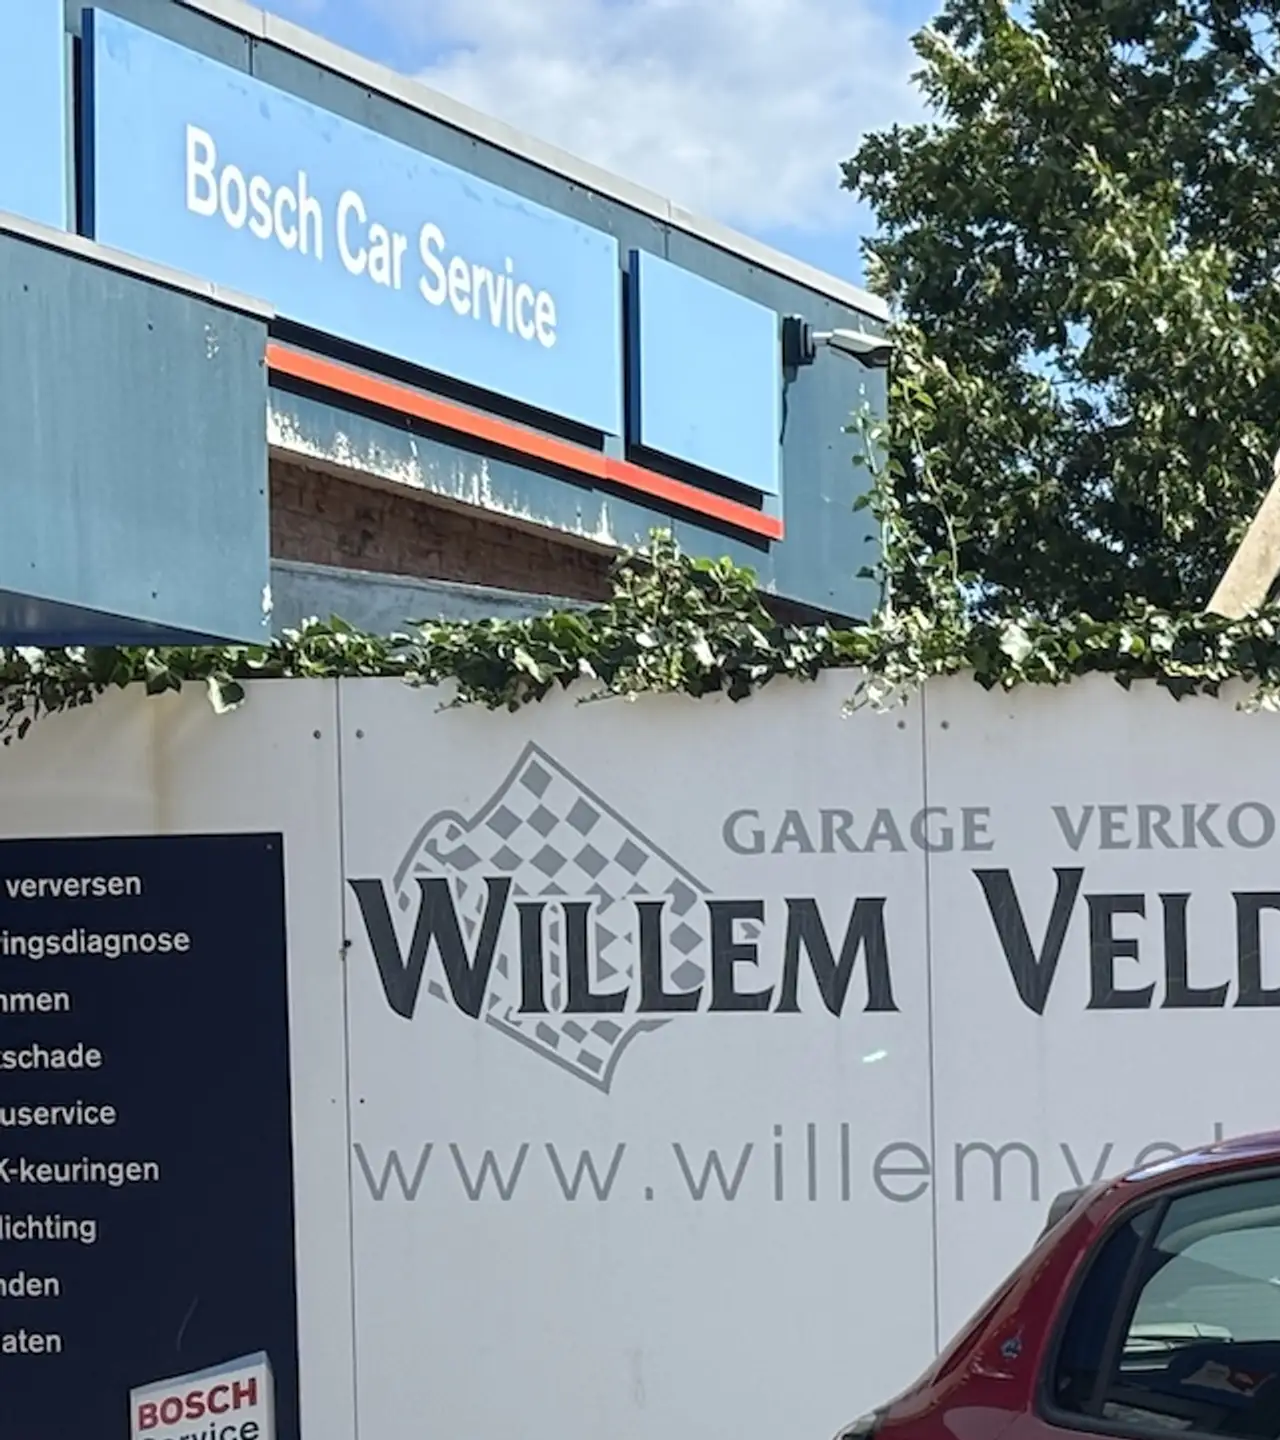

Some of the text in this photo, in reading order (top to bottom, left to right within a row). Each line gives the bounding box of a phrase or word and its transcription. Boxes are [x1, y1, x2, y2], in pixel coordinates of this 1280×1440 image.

[185, 124, 557, 348] Bosch Car Service
[722, 807, 994, 855] GARAGE
[6, 874, 142, 898] verversen
[0, 929, 190, 959] ingsdiagnose
[347, 876, 901, 1020] WILLEM
[0, 1043, 102, 1069] schade
[138, 1377, 259, 1431] BOSCH
